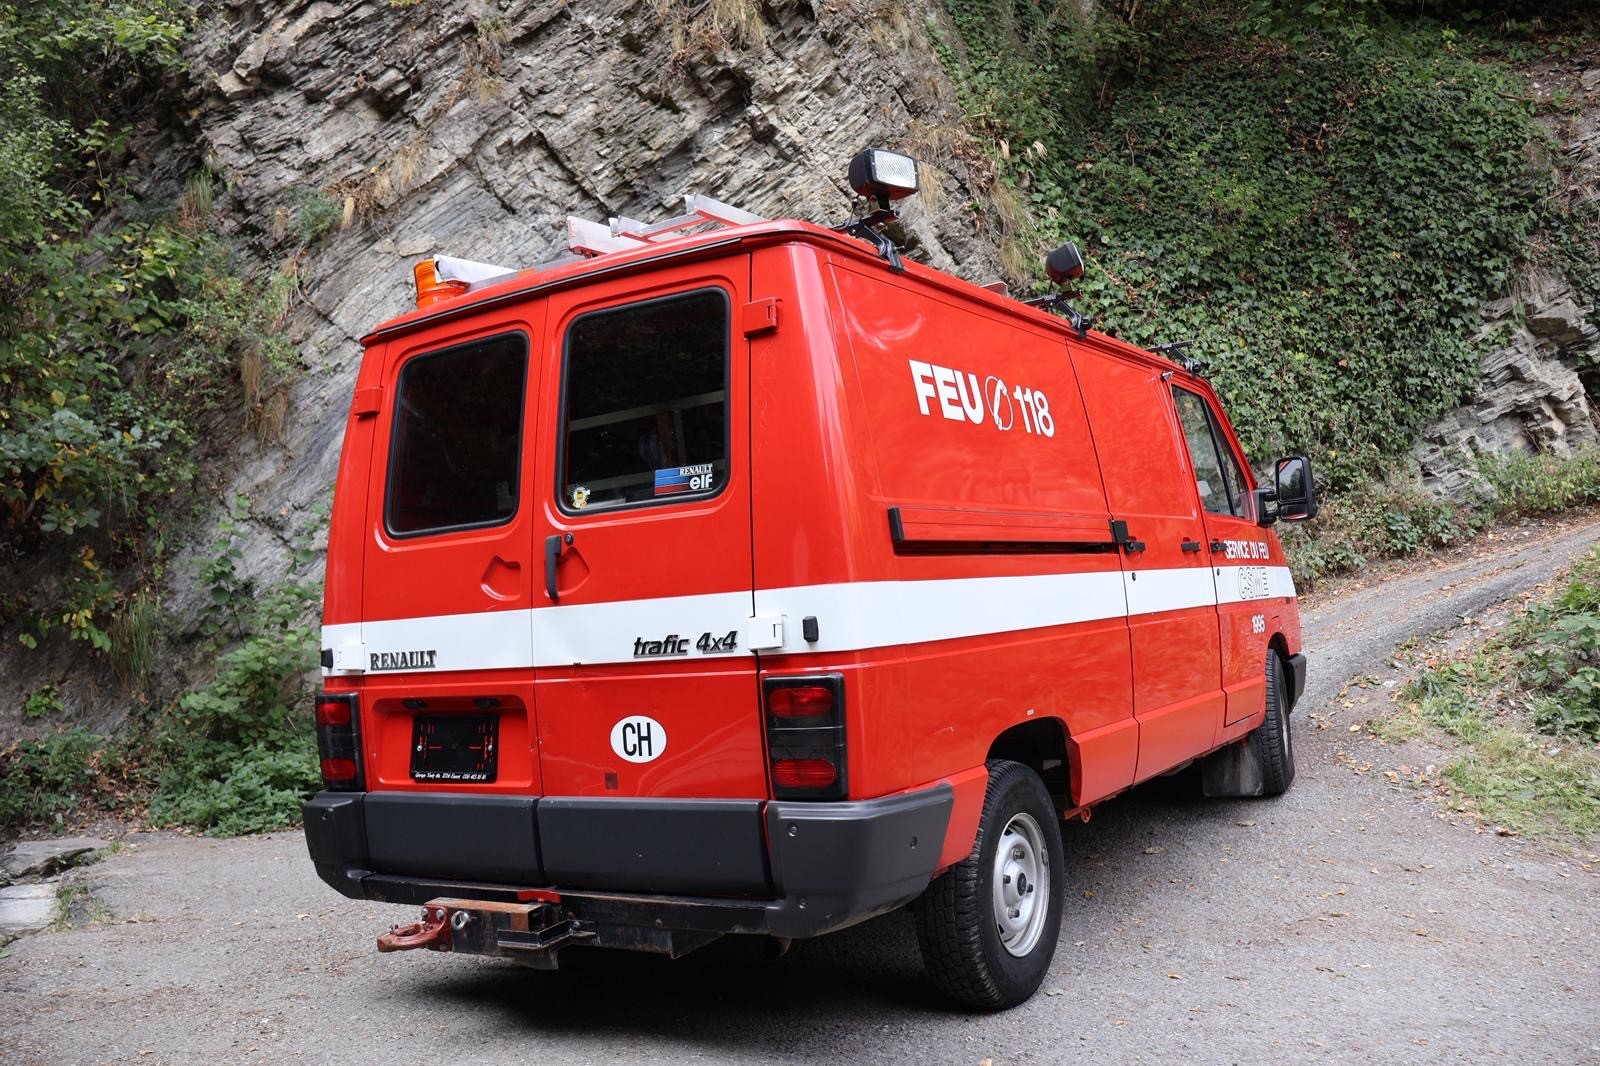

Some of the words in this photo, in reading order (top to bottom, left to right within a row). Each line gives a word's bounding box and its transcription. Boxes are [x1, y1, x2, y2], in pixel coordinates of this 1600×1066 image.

[909, 359, 984, 424] FEU
[1013, 385, 1055, 438] 118
[679, 463, 713, 477] RENAULT
[689, 473, 713, 490] elf
[1223, 540, 1251, 560] SERVICE
[1249, 541, 1260, 560] DU
[1258, 542, 1270, 560] FEU
[633, 634, 690, 657] trafic
[696, 630, 738, 654] 4x4
[370, 650, 437, 671] RENAULT
[622, 722, 653, 757] CH
